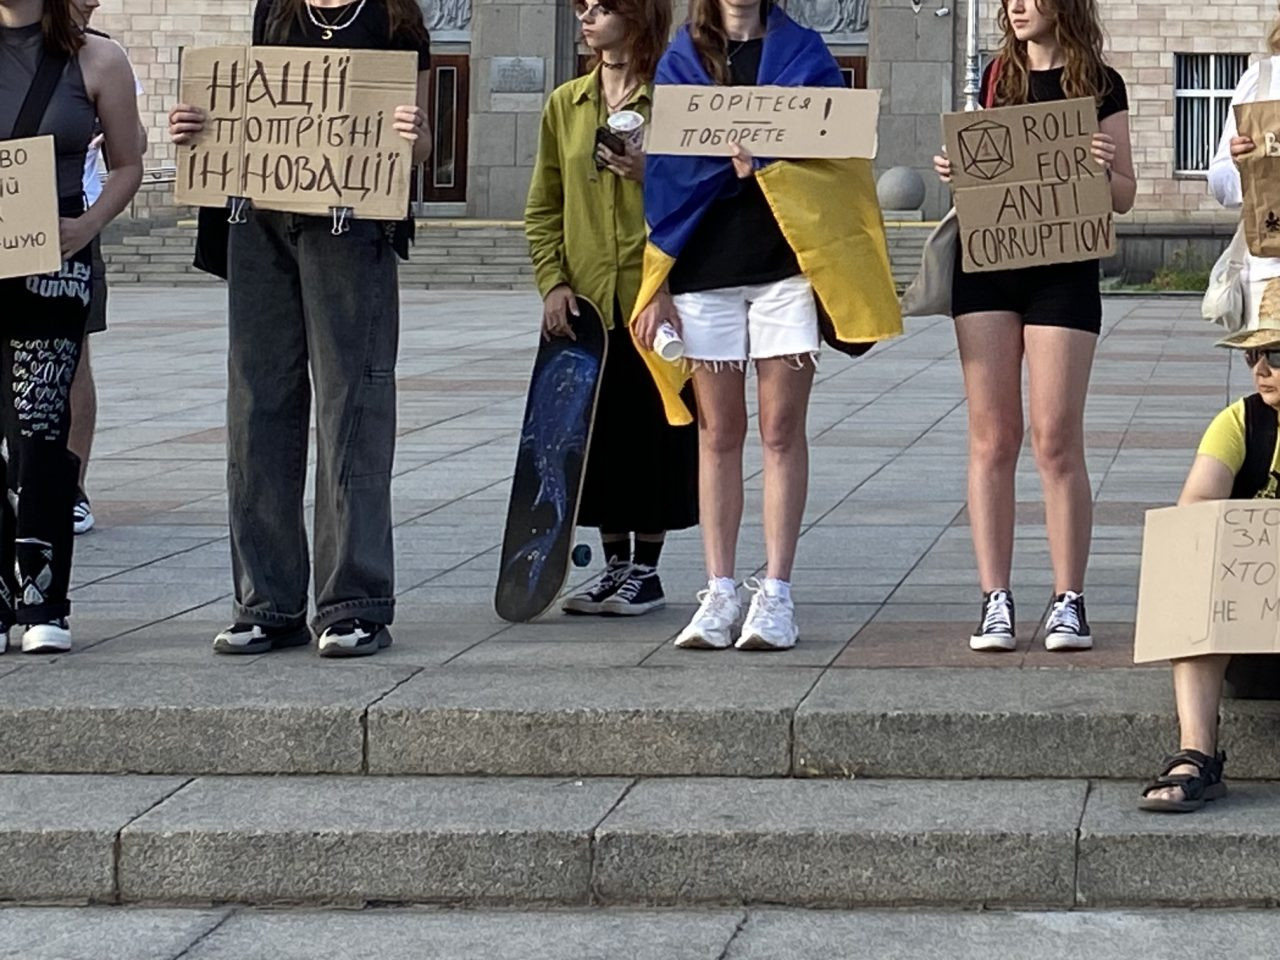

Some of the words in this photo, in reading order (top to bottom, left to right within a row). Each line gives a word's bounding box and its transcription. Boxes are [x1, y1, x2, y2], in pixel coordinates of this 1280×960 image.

[206, 55, 350, 114] НАЦІЇ
[212, 110, 384, 148] ПОТРІБНІ
[680, 128, 787, 147] ПОБОРЕТЕ
[1022, 110, 1089, 145] ROLL
[1037, 147, 1095, 182] FOR
[996, 181, 1080, 224] ANTI
[968, 212, 1112, 267] CORRUPTION
[1233, 529, 1271, 548] ЗА
[1220, 558, 1277, 586] ХТО
[1212, 600, 1239, 622] НЕ
